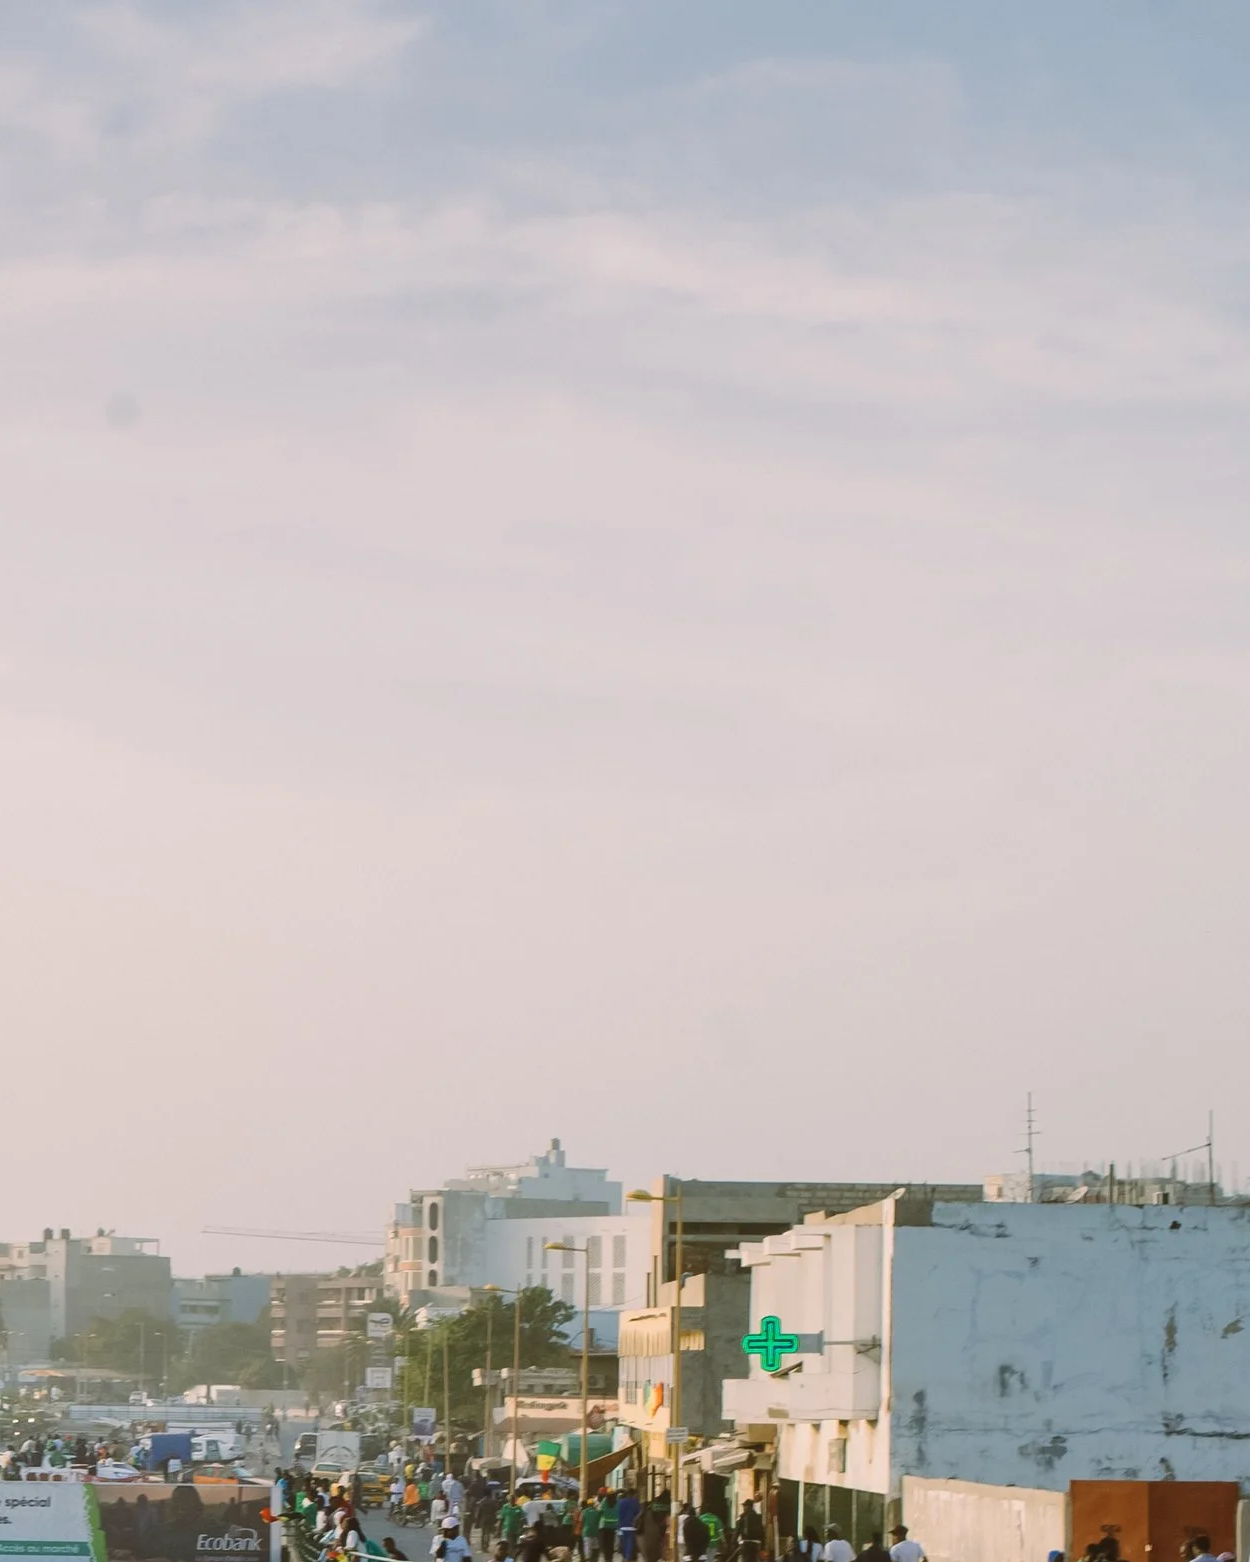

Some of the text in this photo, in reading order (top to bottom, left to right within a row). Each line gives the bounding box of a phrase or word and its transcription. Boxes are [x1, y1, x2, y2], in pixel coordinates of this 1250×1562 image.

[5, 1497, 51, 1508] spécial
[196, 1530, 263, 1551] Ecobank
[27, 1545, 38, 1554] au
[41, 1545, 80, 1554] marché
